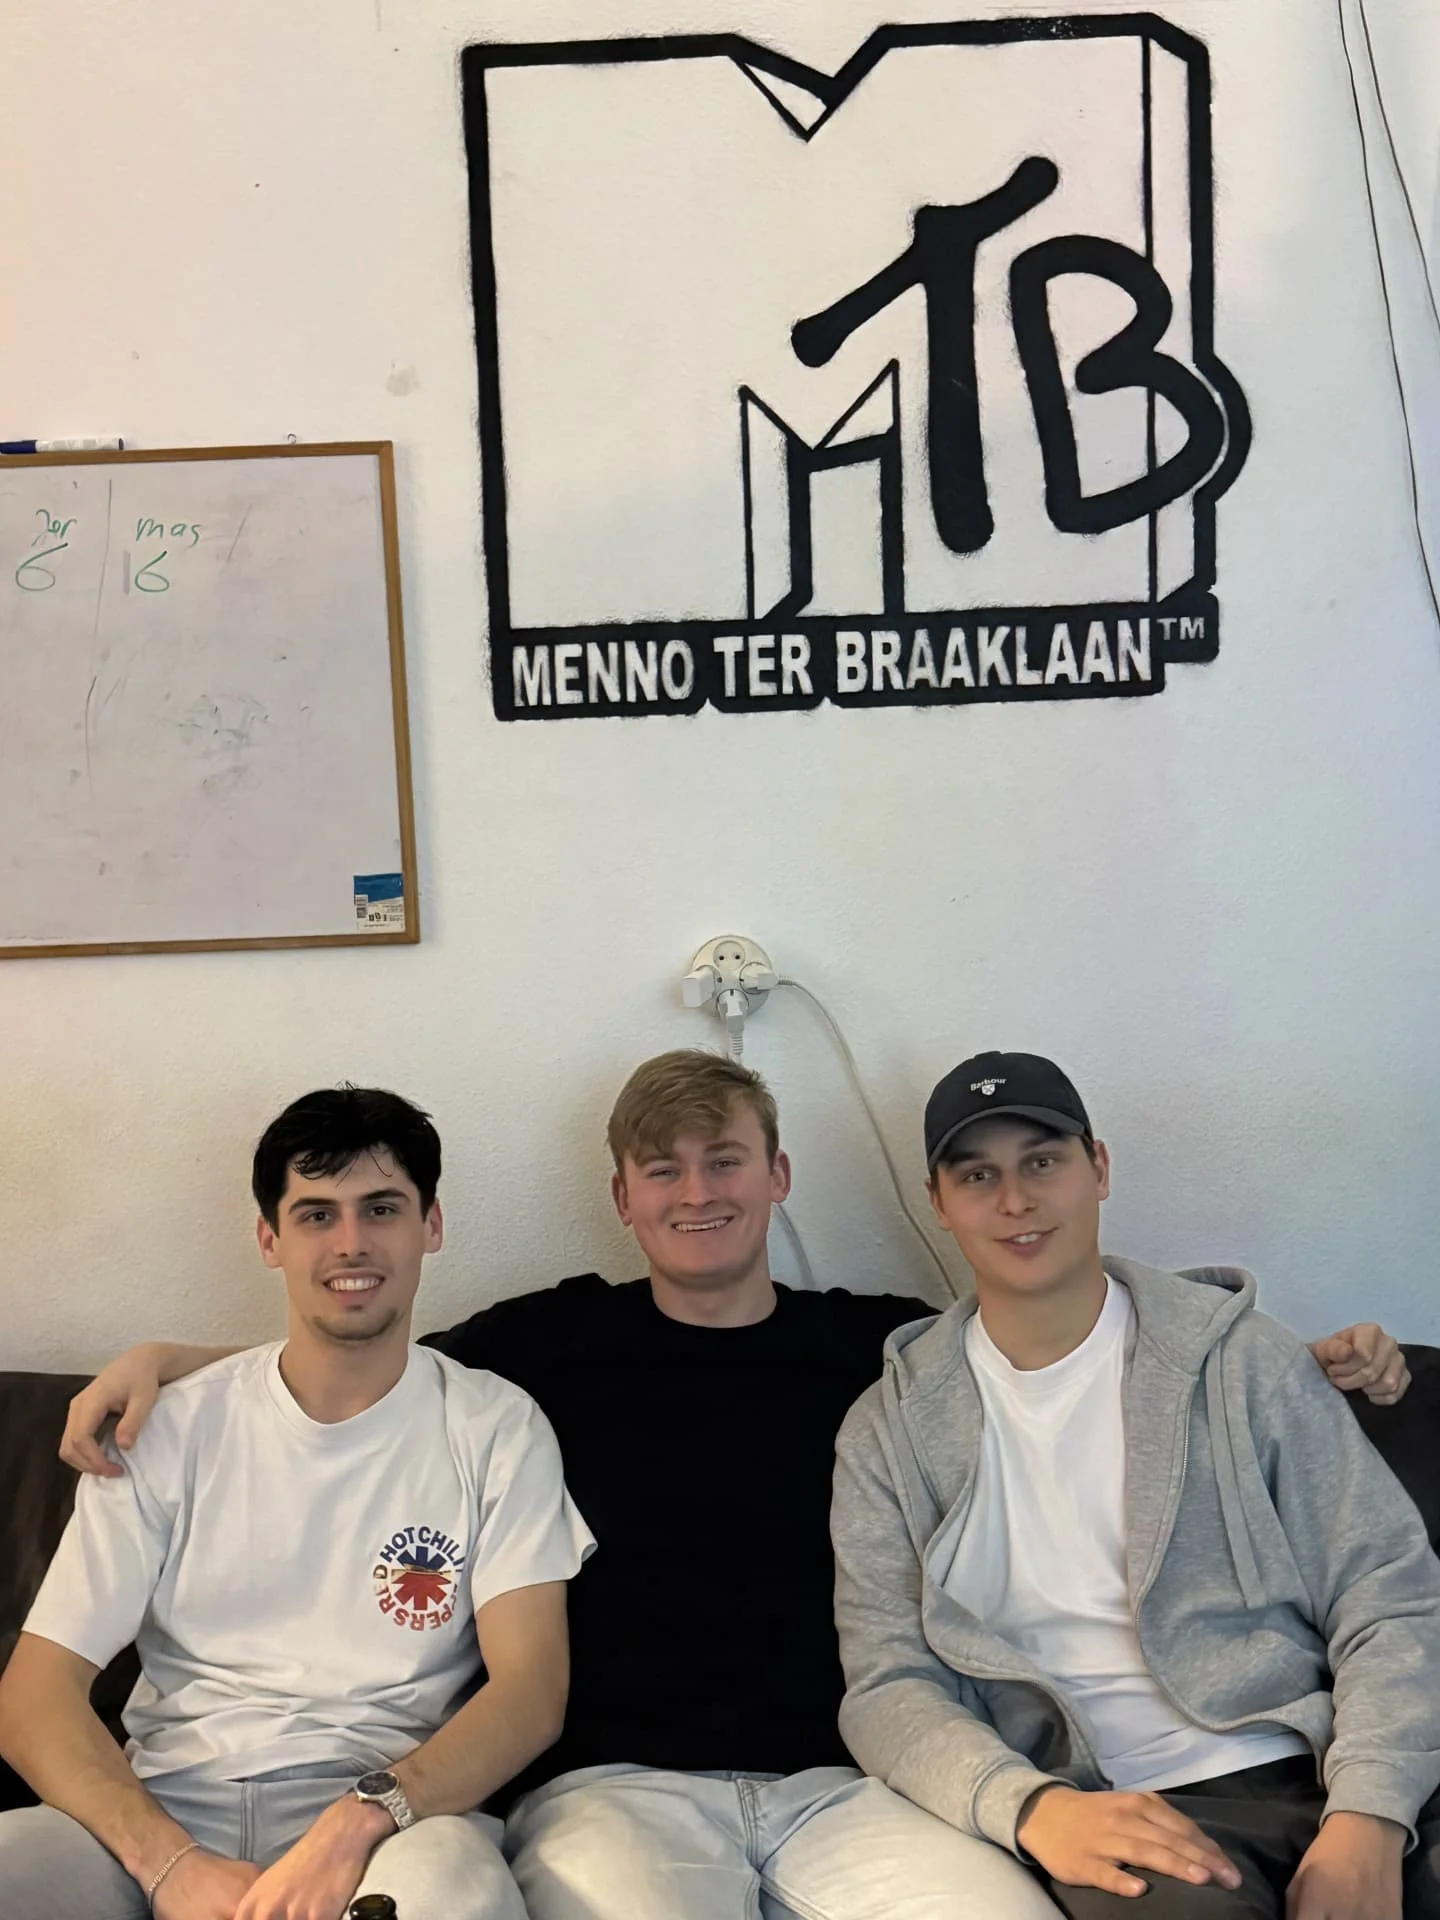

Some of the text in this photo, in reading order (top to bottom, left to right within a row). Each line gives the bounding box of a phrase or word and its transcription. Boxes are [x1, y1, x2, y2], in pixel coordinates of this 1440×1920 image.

[15, 542, 69, 592] 6
[511, 616, 1206, 708] MENNO TER BRAAKLAAN TM
